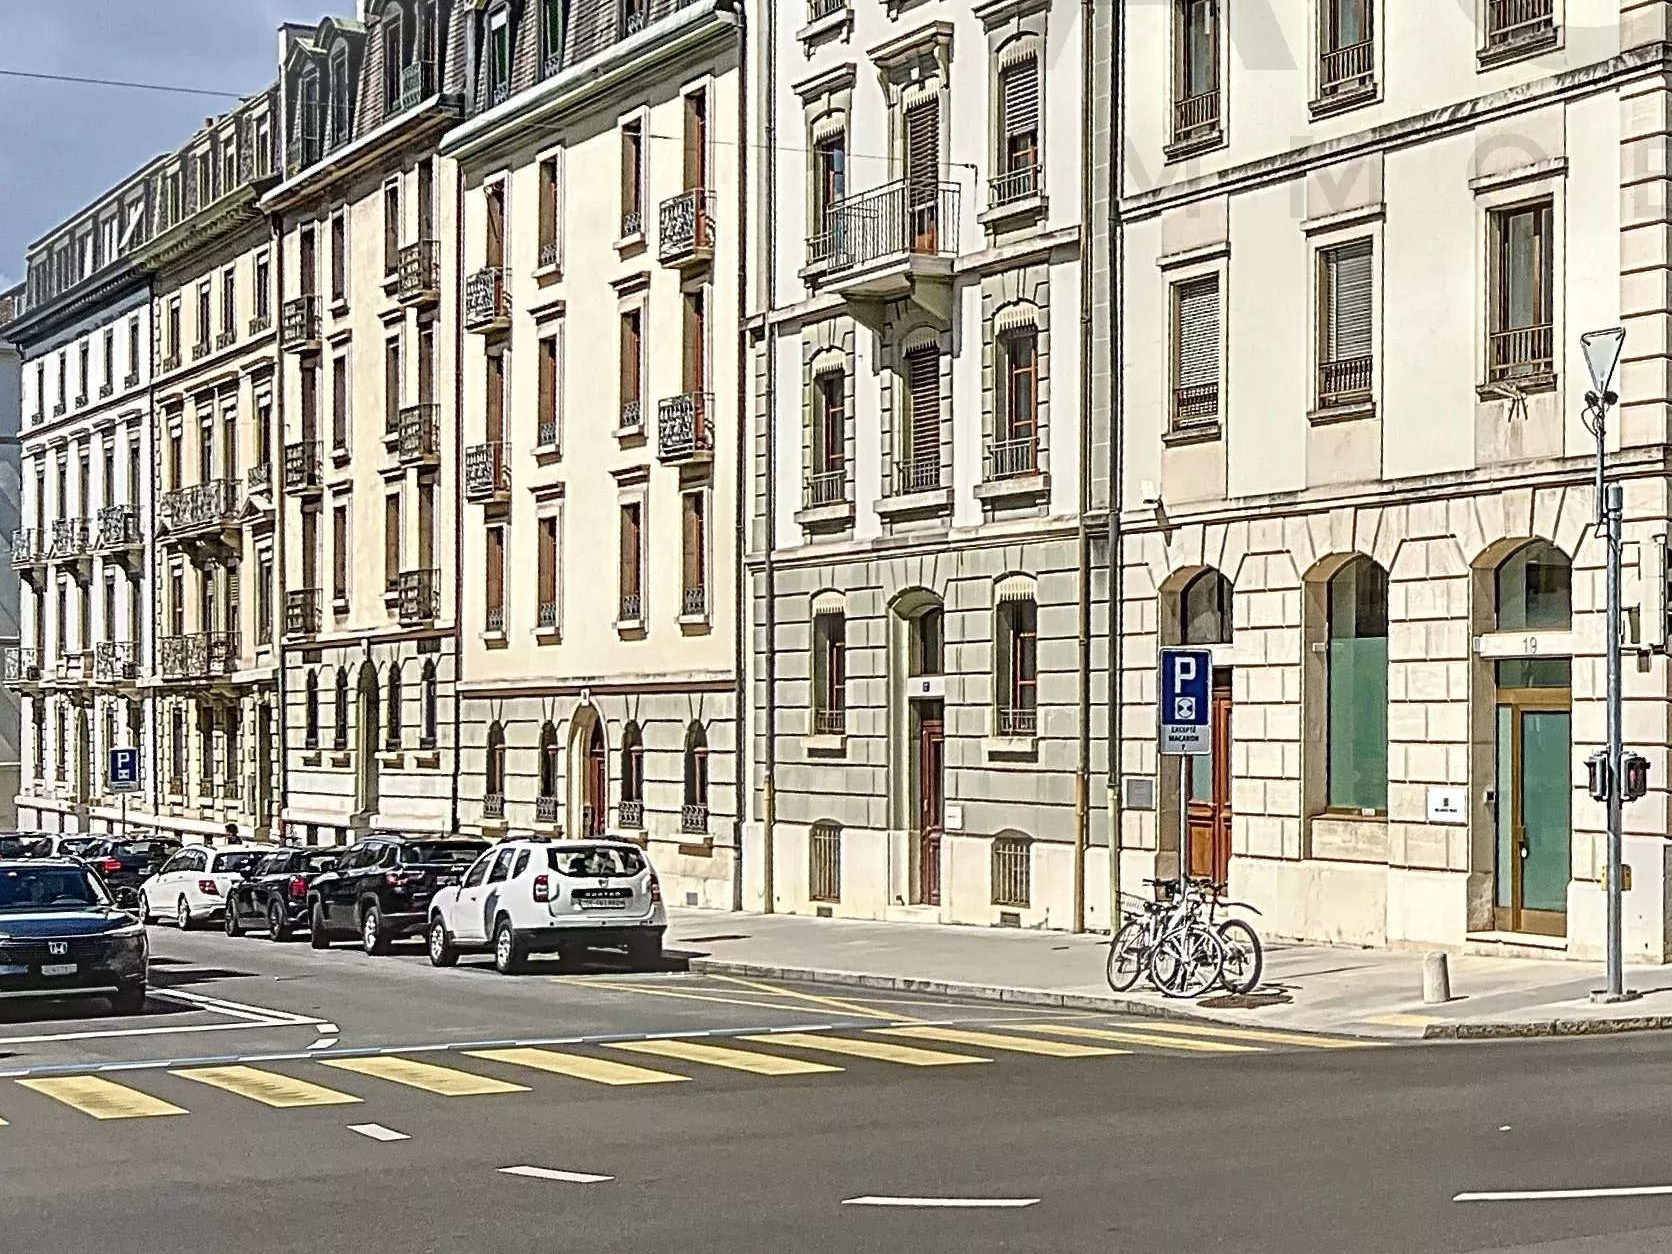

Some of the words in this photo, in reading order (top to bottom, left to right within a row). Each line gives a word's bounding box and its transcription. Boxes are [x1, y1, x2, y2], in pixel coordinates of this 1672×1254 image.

[1523, 636, 1538, 654] 19
[1174, 656, 1197, 694] P
[117, 752, 130, 768] P
